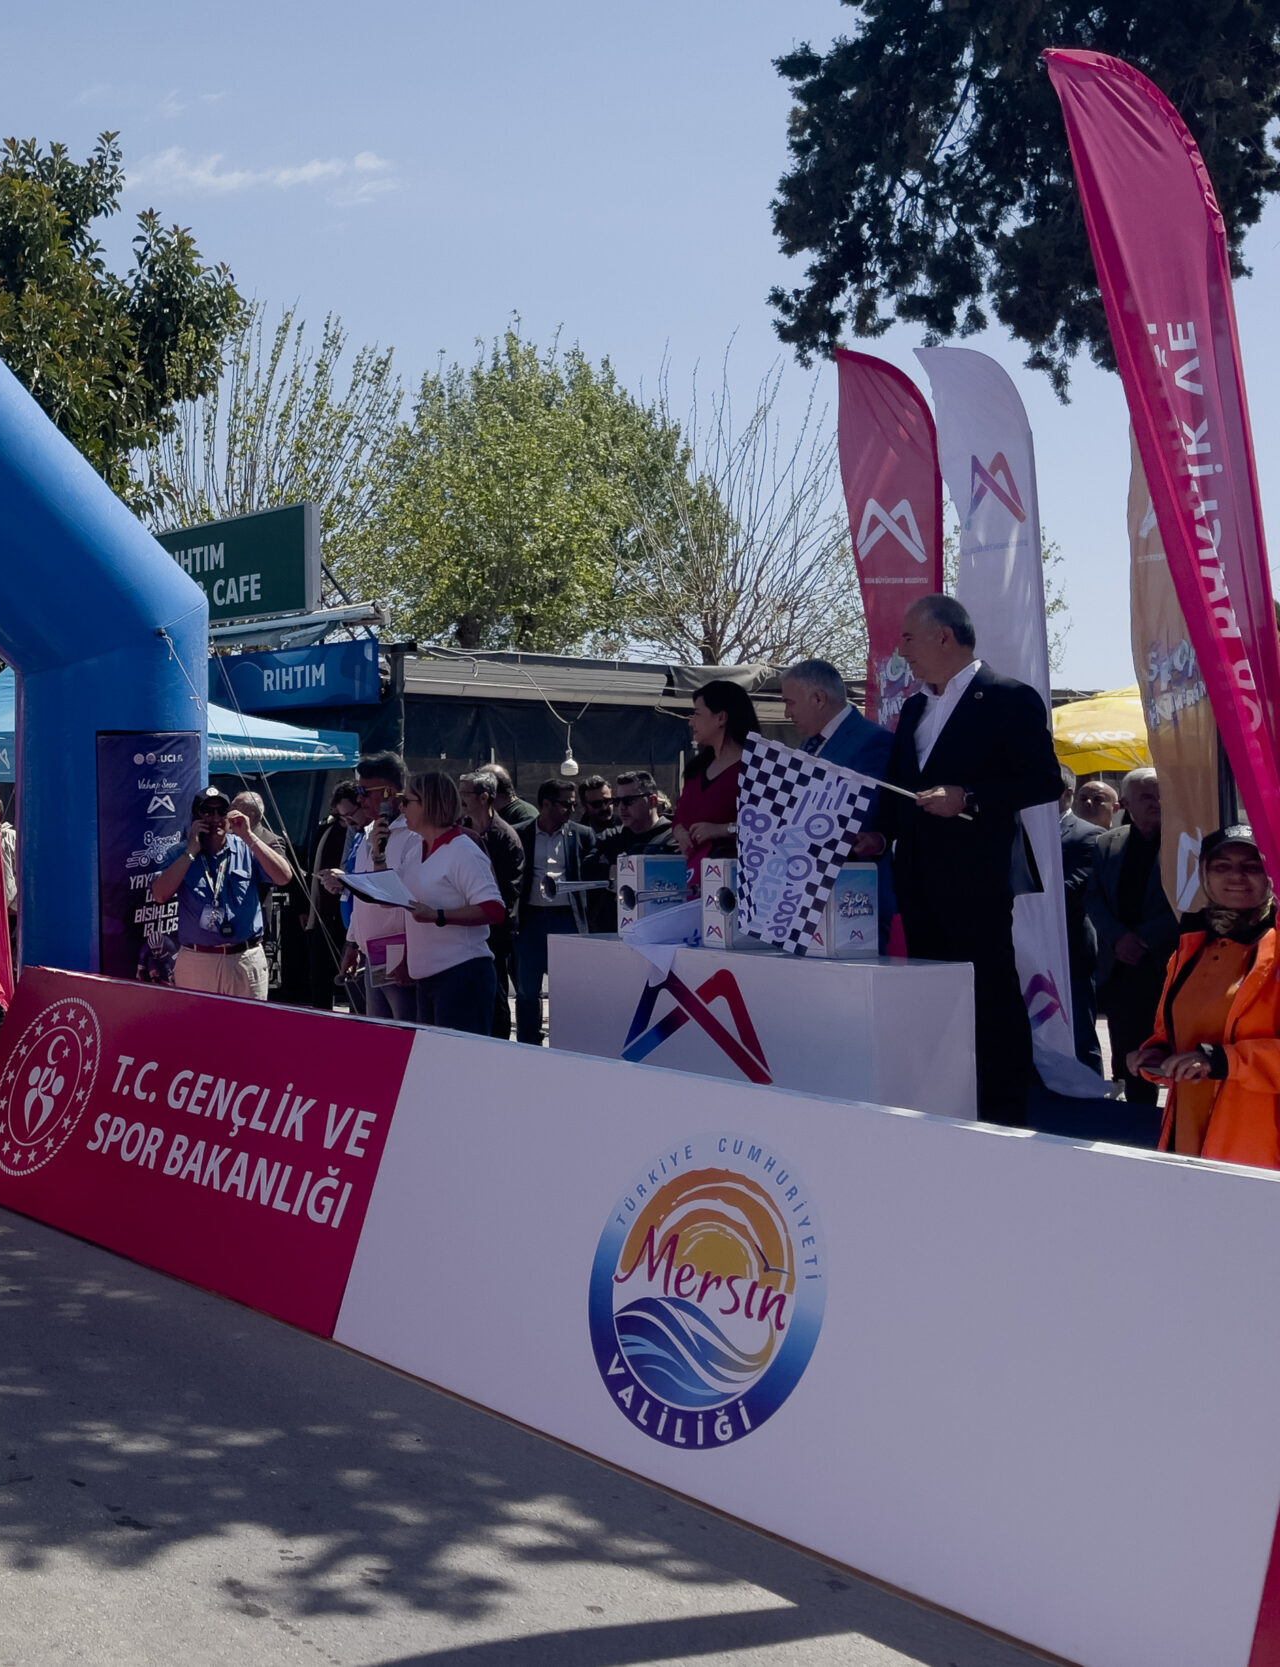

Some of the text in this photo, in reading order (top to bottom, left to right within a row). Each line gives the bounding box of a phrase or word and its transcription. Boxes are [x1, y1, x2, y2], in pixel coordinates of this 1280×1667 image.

[171, 542, 225, 574] IHTIM
[213, 573, 261, 606] CAFE
[263, 663, 326, 692] RIHTIM
[111, 1055, 377, 1159] T.C. GENÇLİK VE
[86, 1112, 353, 1229] SPOR BAKANLIĞI
[615, 1137, 823, 1281] TÜRKİYE CUMHURİYETİ
[613, 1225, 787, 1331] Mersin
[606, 1353, 752, 1446] VALİLİĞİ
